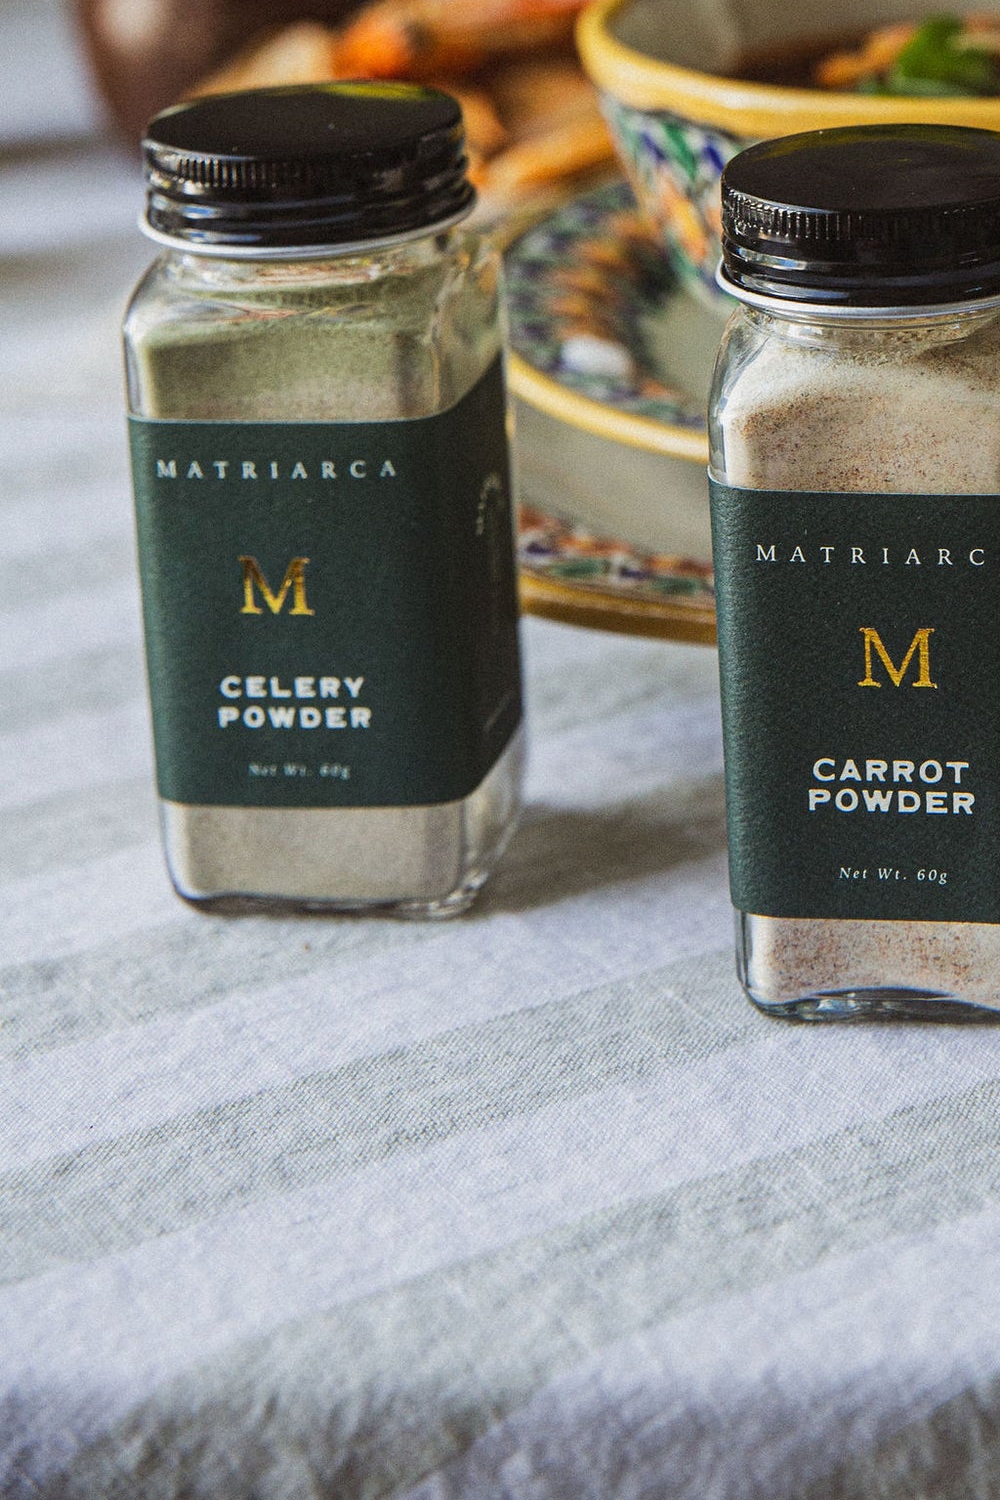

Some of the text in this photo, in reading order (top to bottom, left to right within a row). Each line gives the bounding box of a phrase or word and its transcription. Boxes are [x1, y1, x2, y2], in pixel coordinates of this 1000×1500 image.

[155, 458, 397, 480] MATRIARCA
[238, 555, 315, 617] M
[856, 626, 939, 690] M
[218, 674, 365, 700] CELERY
[216, 704, 373, 730] POWDER
[811, 756, 971, 785] CARROT
[807, 786, 977, 816] POWDER
[838, 865, 949, 887] Net Wt. 60g
